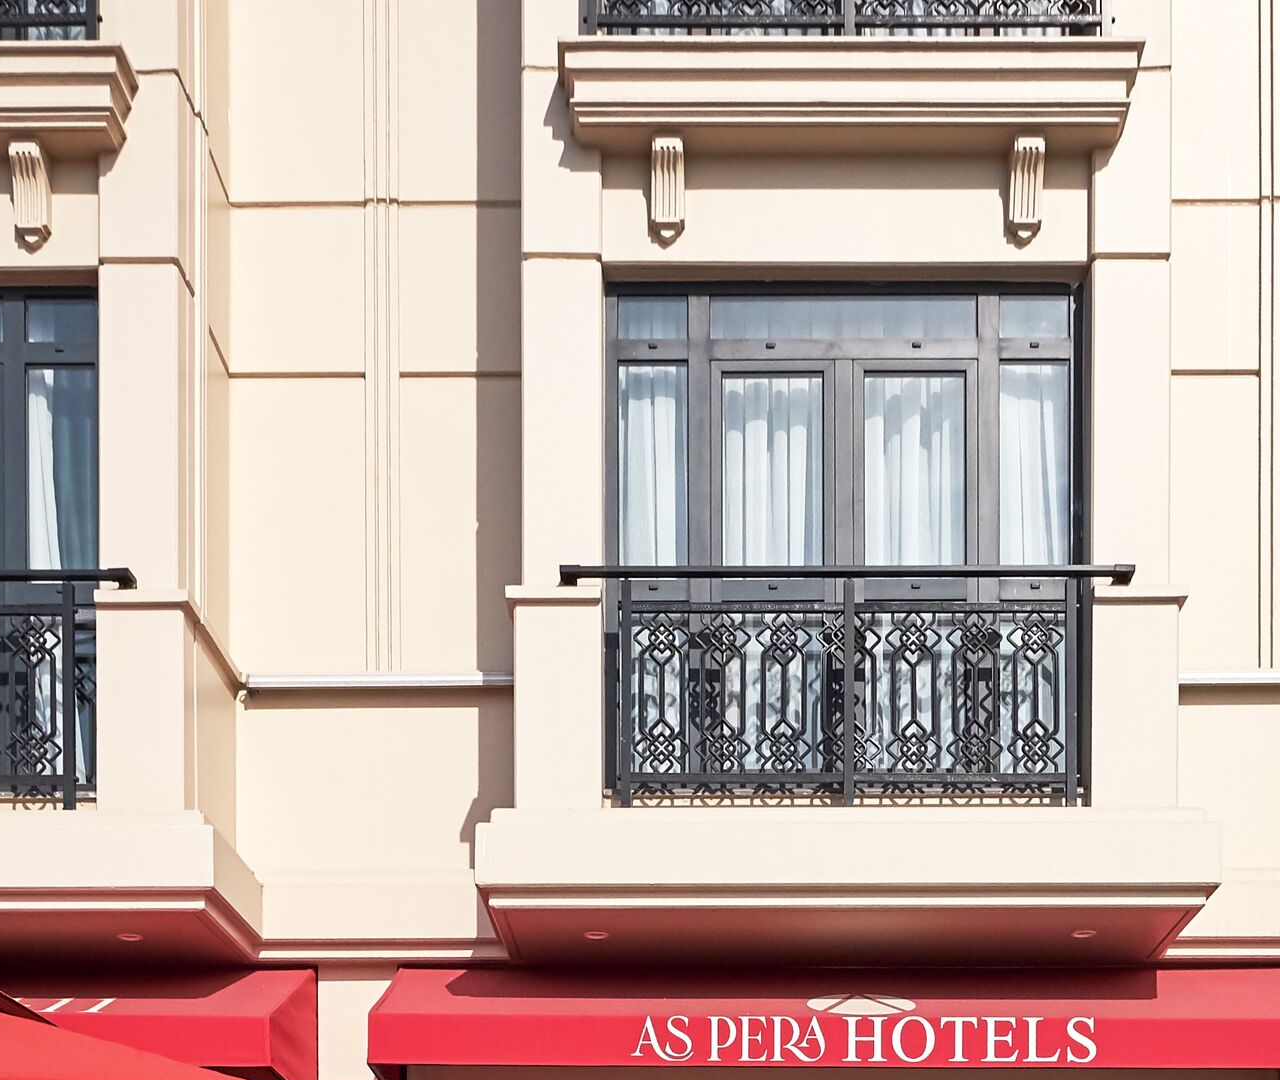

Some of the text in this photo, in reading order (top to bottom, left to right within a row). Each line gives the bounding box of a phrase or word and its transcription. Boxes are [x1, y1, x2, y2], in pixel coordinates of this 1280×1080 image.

[630, 1015, 1097, 1062] AS PERA HOTELS
